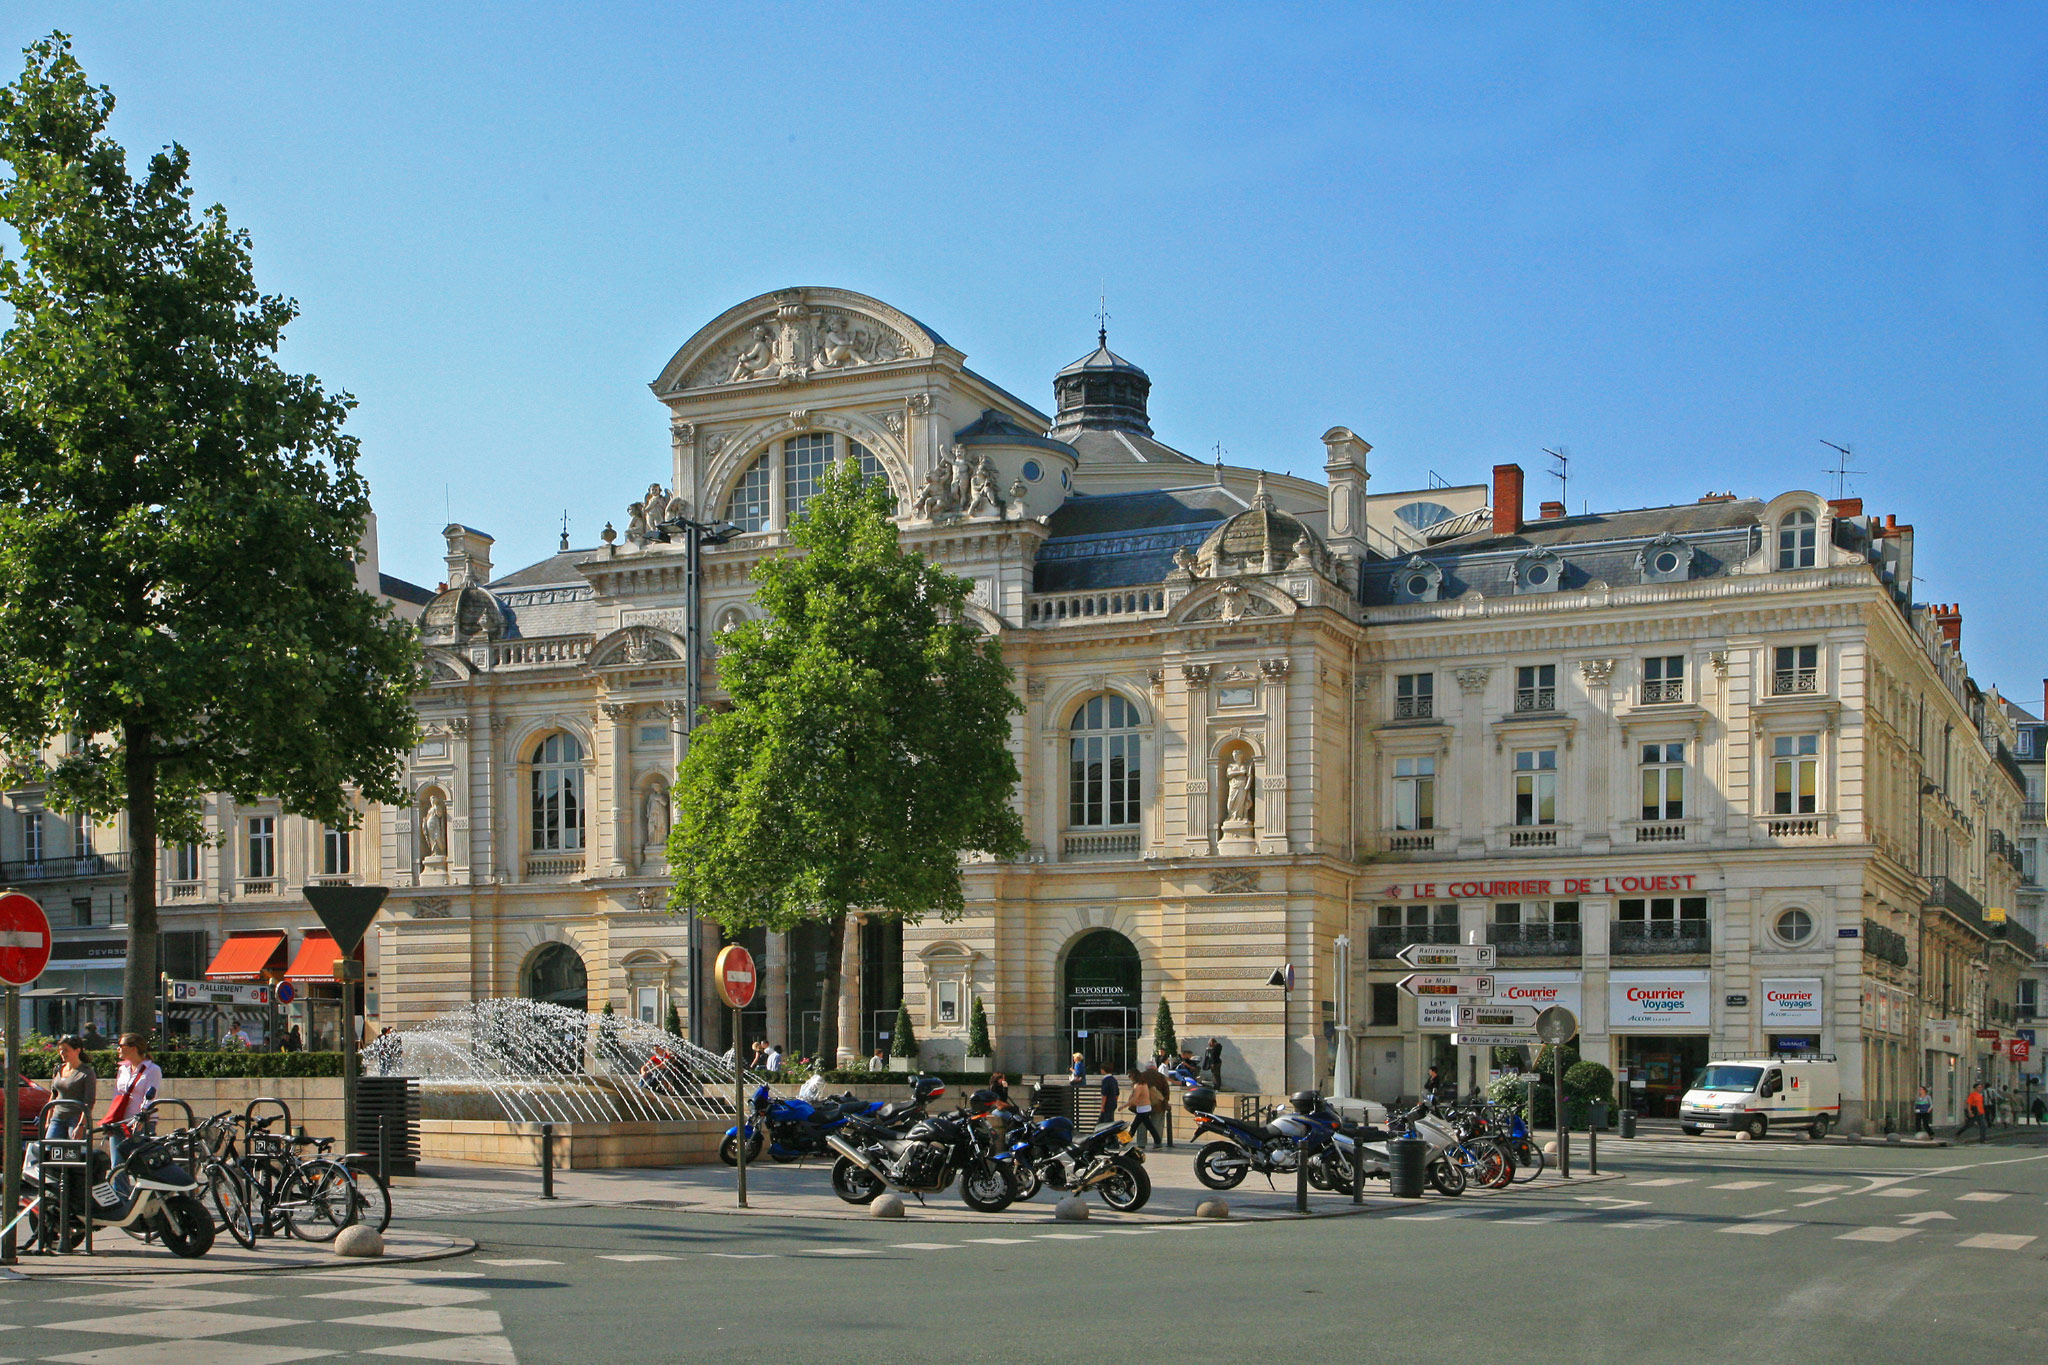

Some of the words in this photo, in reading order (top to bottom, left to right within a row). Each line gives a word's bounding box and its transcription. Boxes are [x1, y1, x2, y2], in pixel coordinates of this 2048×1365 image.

[1413, 883, 1436, 898] LE
[1448, 880, 1551, 897] COURRIER
[1564, 879, 1591, 894] DE
[1604, 875, 1697, 893] L'OUEST
[1480, 950, 1488, 959] P
[199, 983, 244, 993] RALLIEMENT
[1480, 979, 1488, 989] P
[1075, 986, 1124, 994] EXPOSITION
[1508, 986, 1558, 999] Courrier
[1626, 987, 1685, 1001] Courrier
[1767, 991, 1813, 1001] Courrier
[1642, 1000, 1685, 1011] Voyages
[1779, 1000, 1813, 1008] Voyages
[1463, 1009, 1471, 1019] P
[1476, 1007, 1514, 1015] République
[257, 1141, 264, 1150] P
[53, 1148, 60, 1159] P
